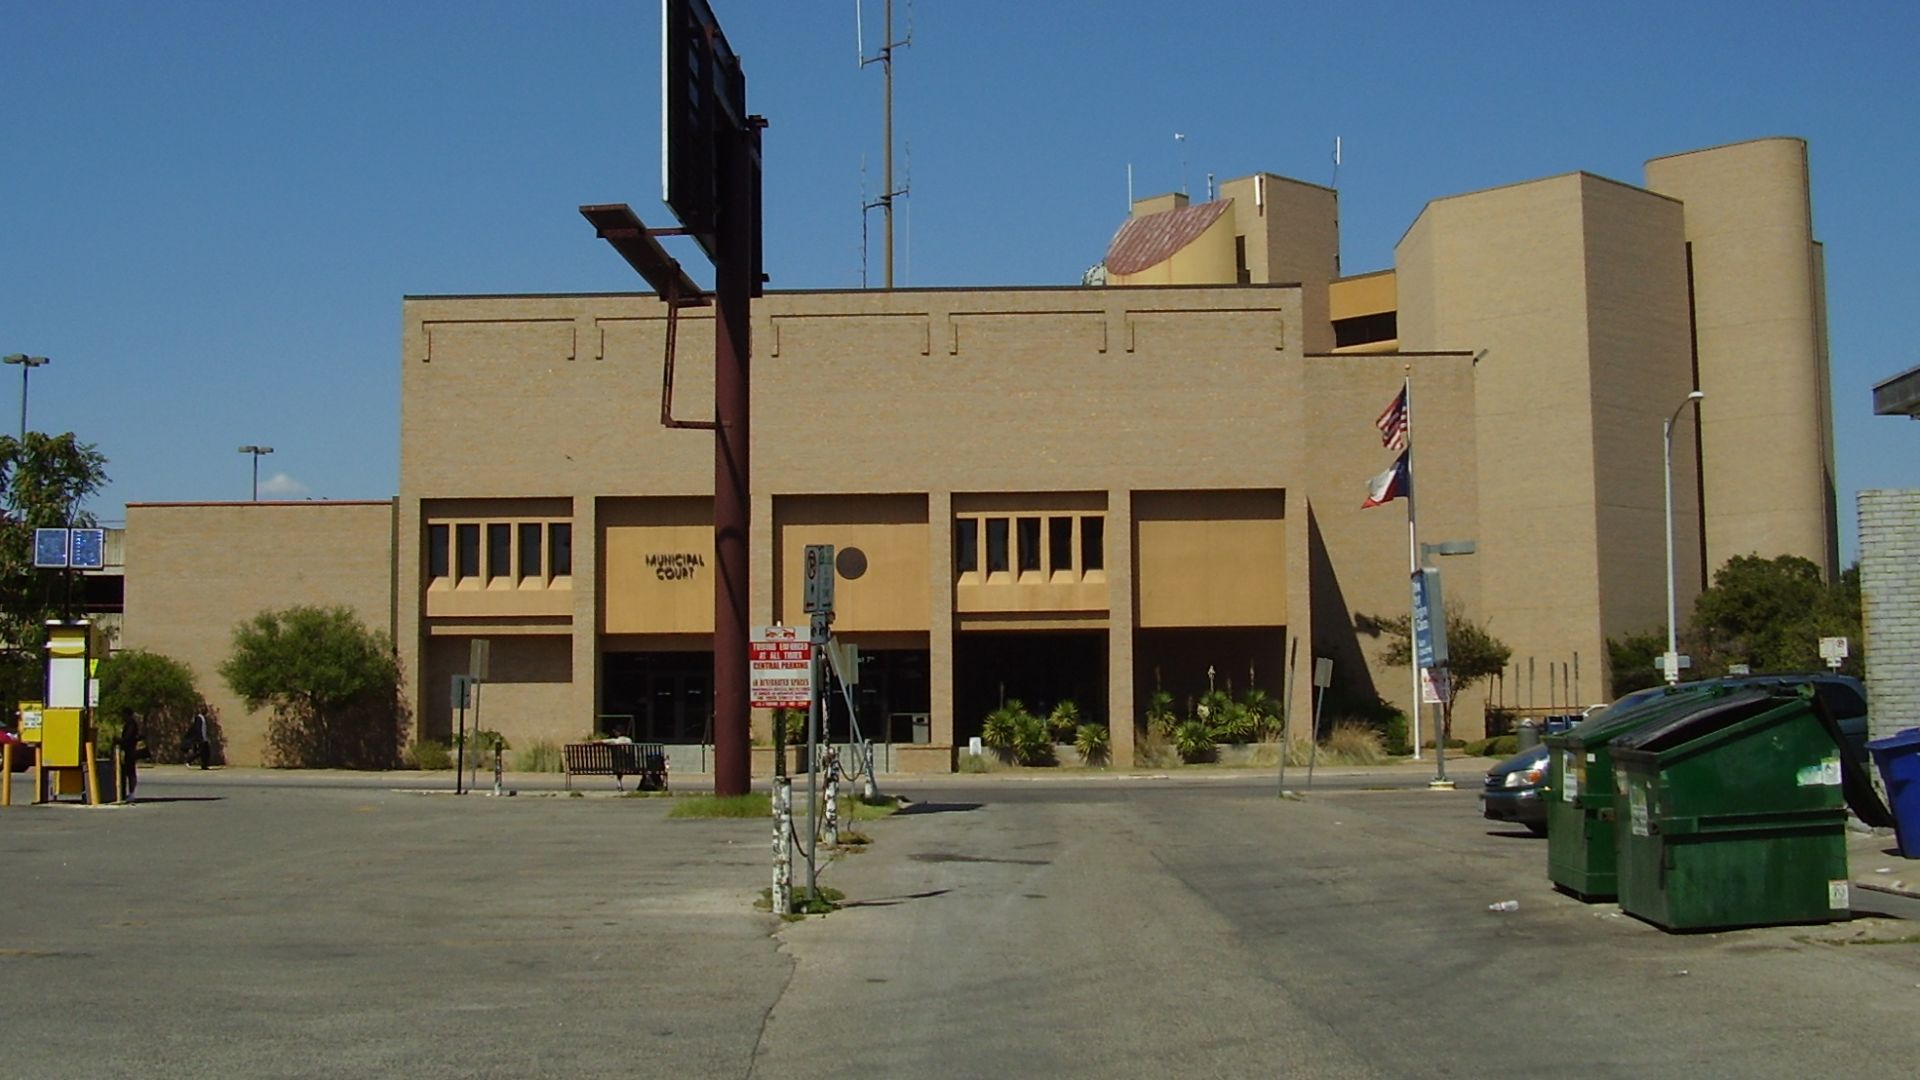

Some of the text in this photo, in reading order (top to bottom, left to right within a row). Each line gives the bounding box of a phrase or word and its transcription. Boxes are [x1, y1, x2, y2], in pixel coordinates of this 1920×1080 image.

[645, 553, 705, 567] MUNICIPAL
[656, 567, 695, 581] COURT
[759, 651, 803, 659] AT ALL TIMES
[753, 662, 809, 670] CENTRAL PARKING
